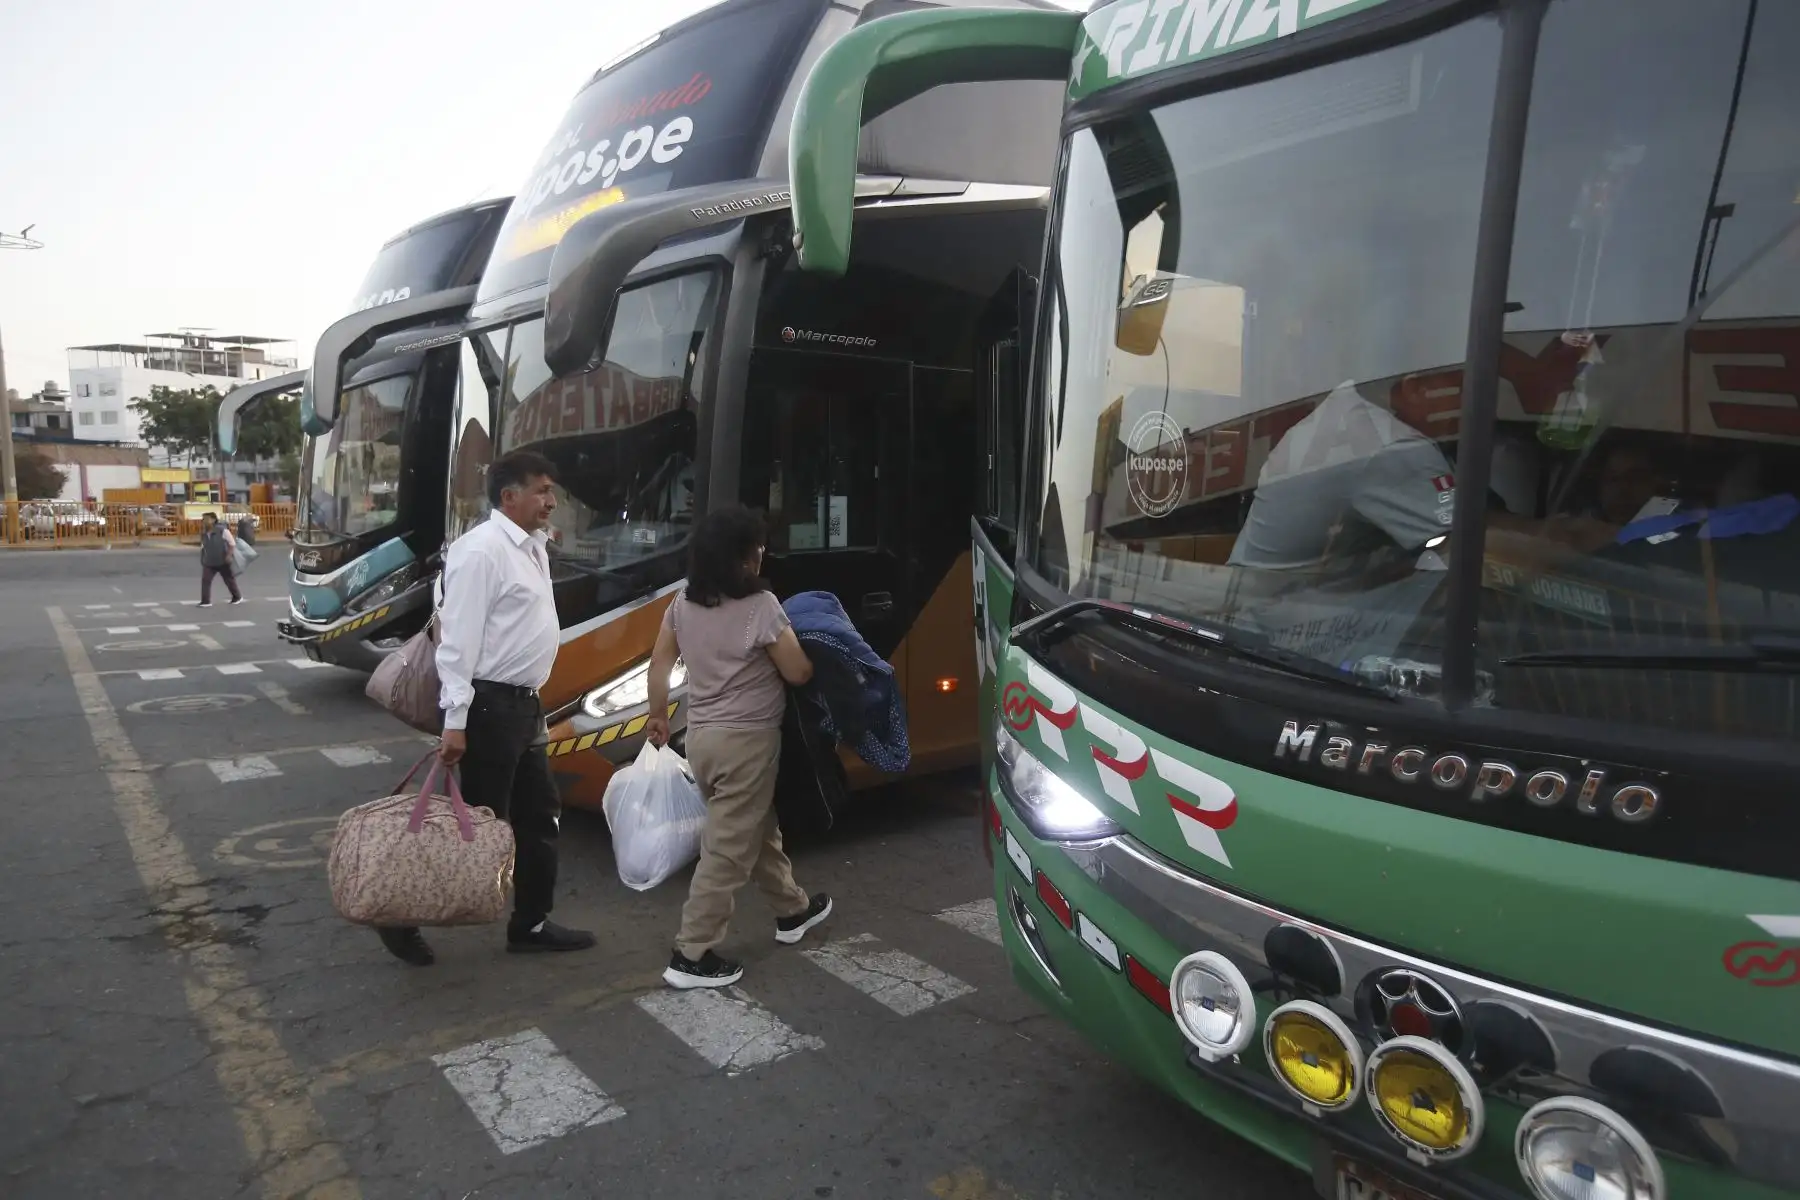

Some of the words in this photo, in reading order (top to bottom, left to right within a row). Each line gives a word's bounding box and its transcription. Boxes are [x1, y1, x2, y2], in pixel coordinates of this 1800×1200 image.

[690, 194, 762, 220] Paradiso
[796, 329, 877, 347] Marcopolo
[1130, 453, 1184, 475] kupos.pe
[1274, 719, 1660, 822] Marcopolo
